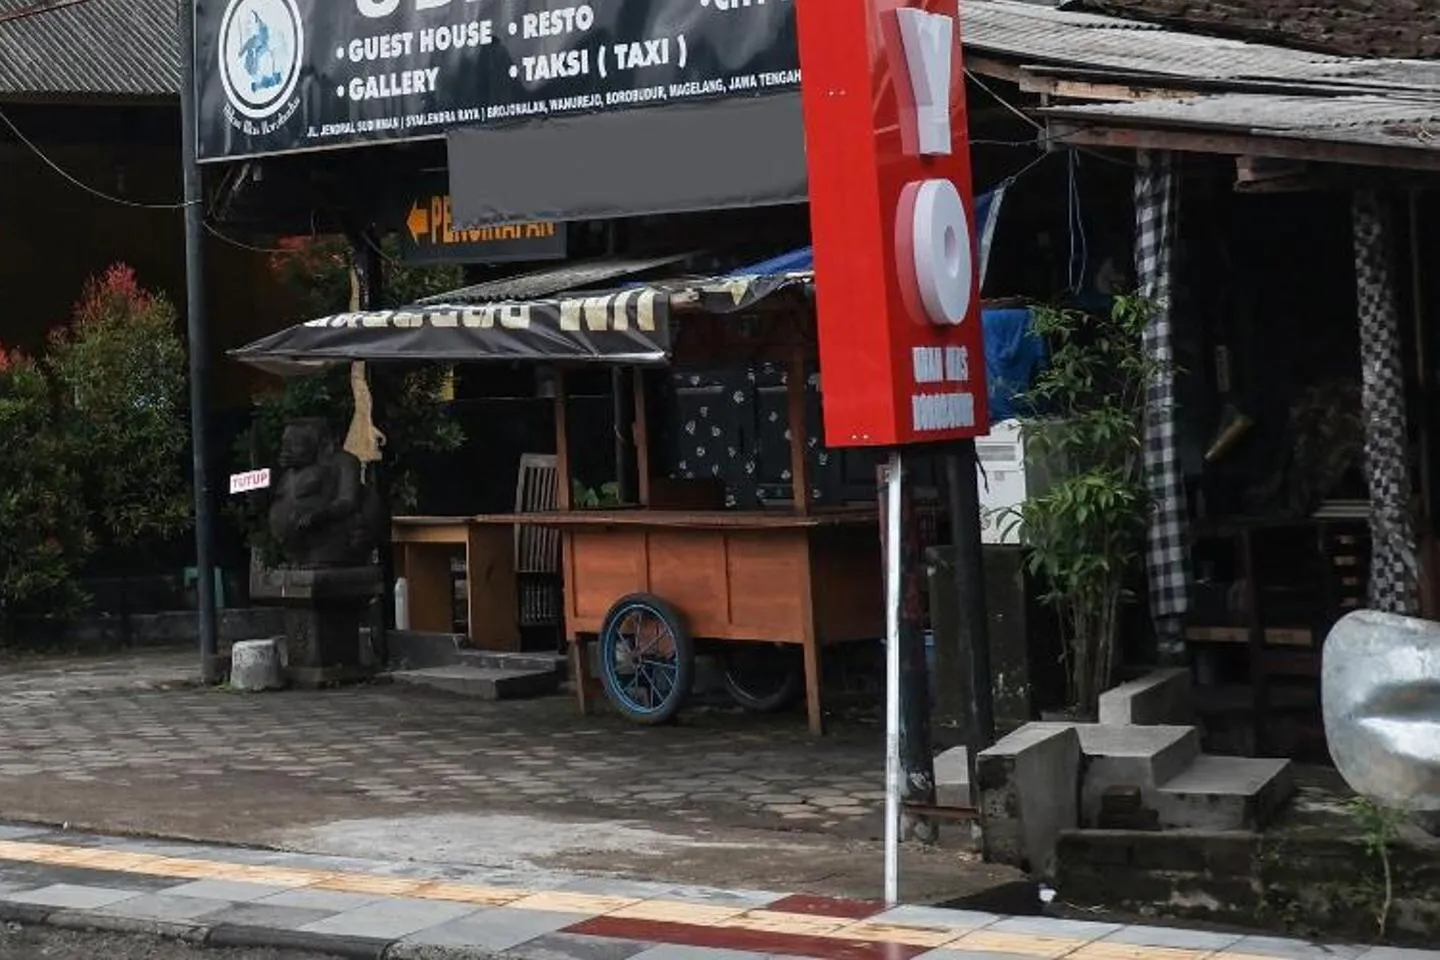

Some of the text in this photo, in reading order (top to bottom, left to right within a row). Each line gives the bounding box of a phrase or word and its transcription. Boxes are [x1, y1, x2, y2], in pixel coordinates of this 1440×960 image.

[523, 5, 594, 39] RESTO
[348, 20, 493, 62] GUEST HOUSE
[522, 49, 589, 82] TAKSI
[728, 73, 758, 91] JAWA
[758, 68, 802, 87] TENGAH
[348, 67, 440, 101] GALLERY
[233, 471, 268, 489] TUTUP
